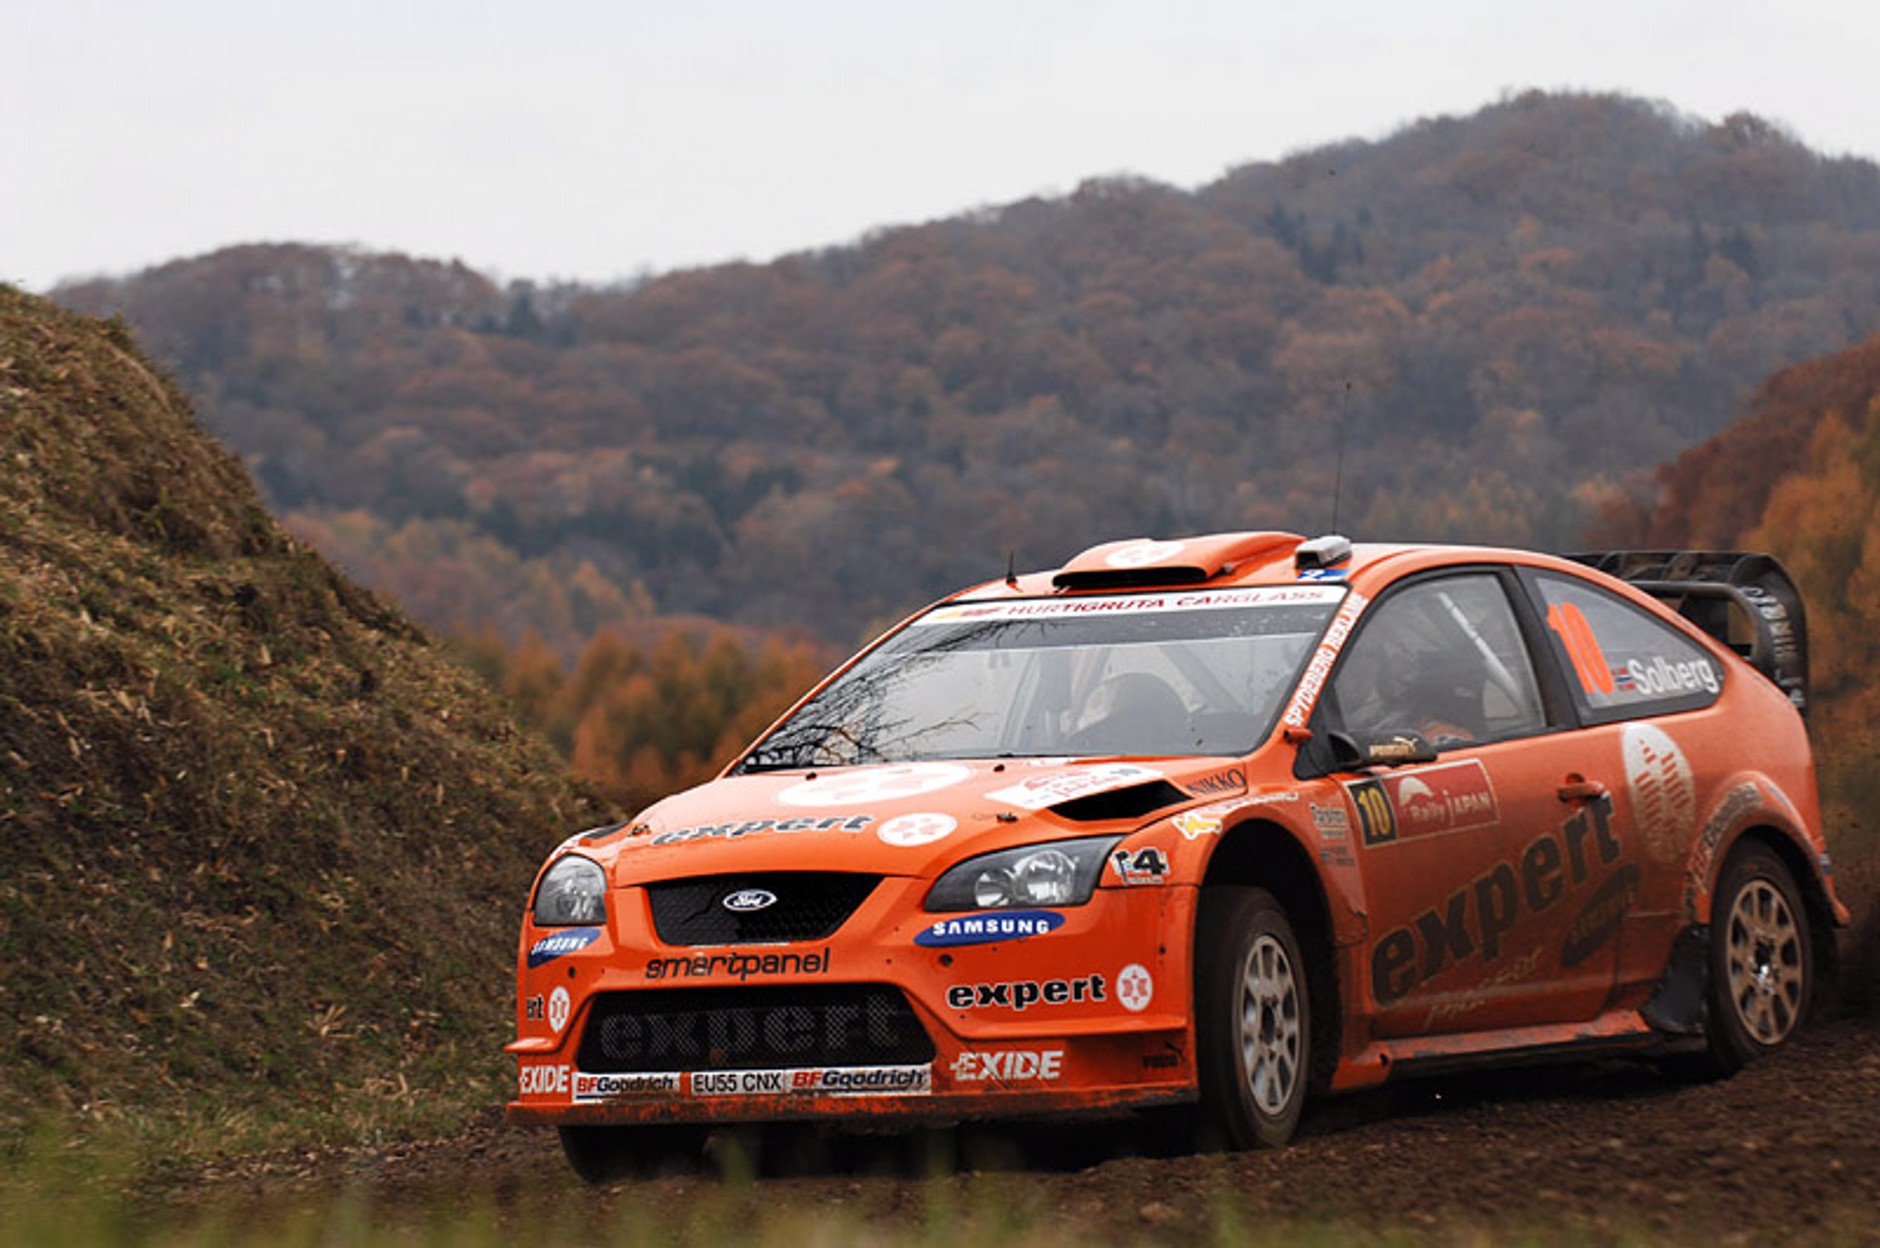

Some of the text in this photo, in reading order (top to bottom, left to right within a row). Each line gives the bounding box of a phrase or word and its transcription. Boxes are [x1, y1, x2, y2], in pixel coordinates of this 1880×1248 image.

[1007, 598, 1165, 616] HURTIGRUTA
[1176, 590, 1324, 608] CARGLASS
[1546, 601, 1615, 694] 10
[1627, 656, 1720, 694] Solberg
[1185, 768, 1247, 795] NIKKO
[1358, 787, 1392, 838] 10
[1409, 802, 1446, 823] Rally
[651, 815, 875, 846] expert
[1371, 788, 1621, 1008] expert
[932, 918, 1050, 937] SAMSUNG
[645, 946, 831, 982] smartpanel
[946, 973, 1107, 1011] expert
[600, 996, 902, 1062] expert
[519, 1064, 572, 1094] EXIDE
[791, 1068, 924, 1090] BFGoodrich
[950, 1050, 1064, 1082] EXIDE
[576, 1074, 674, 1093] BFGoodrich
[693, 1072, 782, 1093] EU55 CNX
